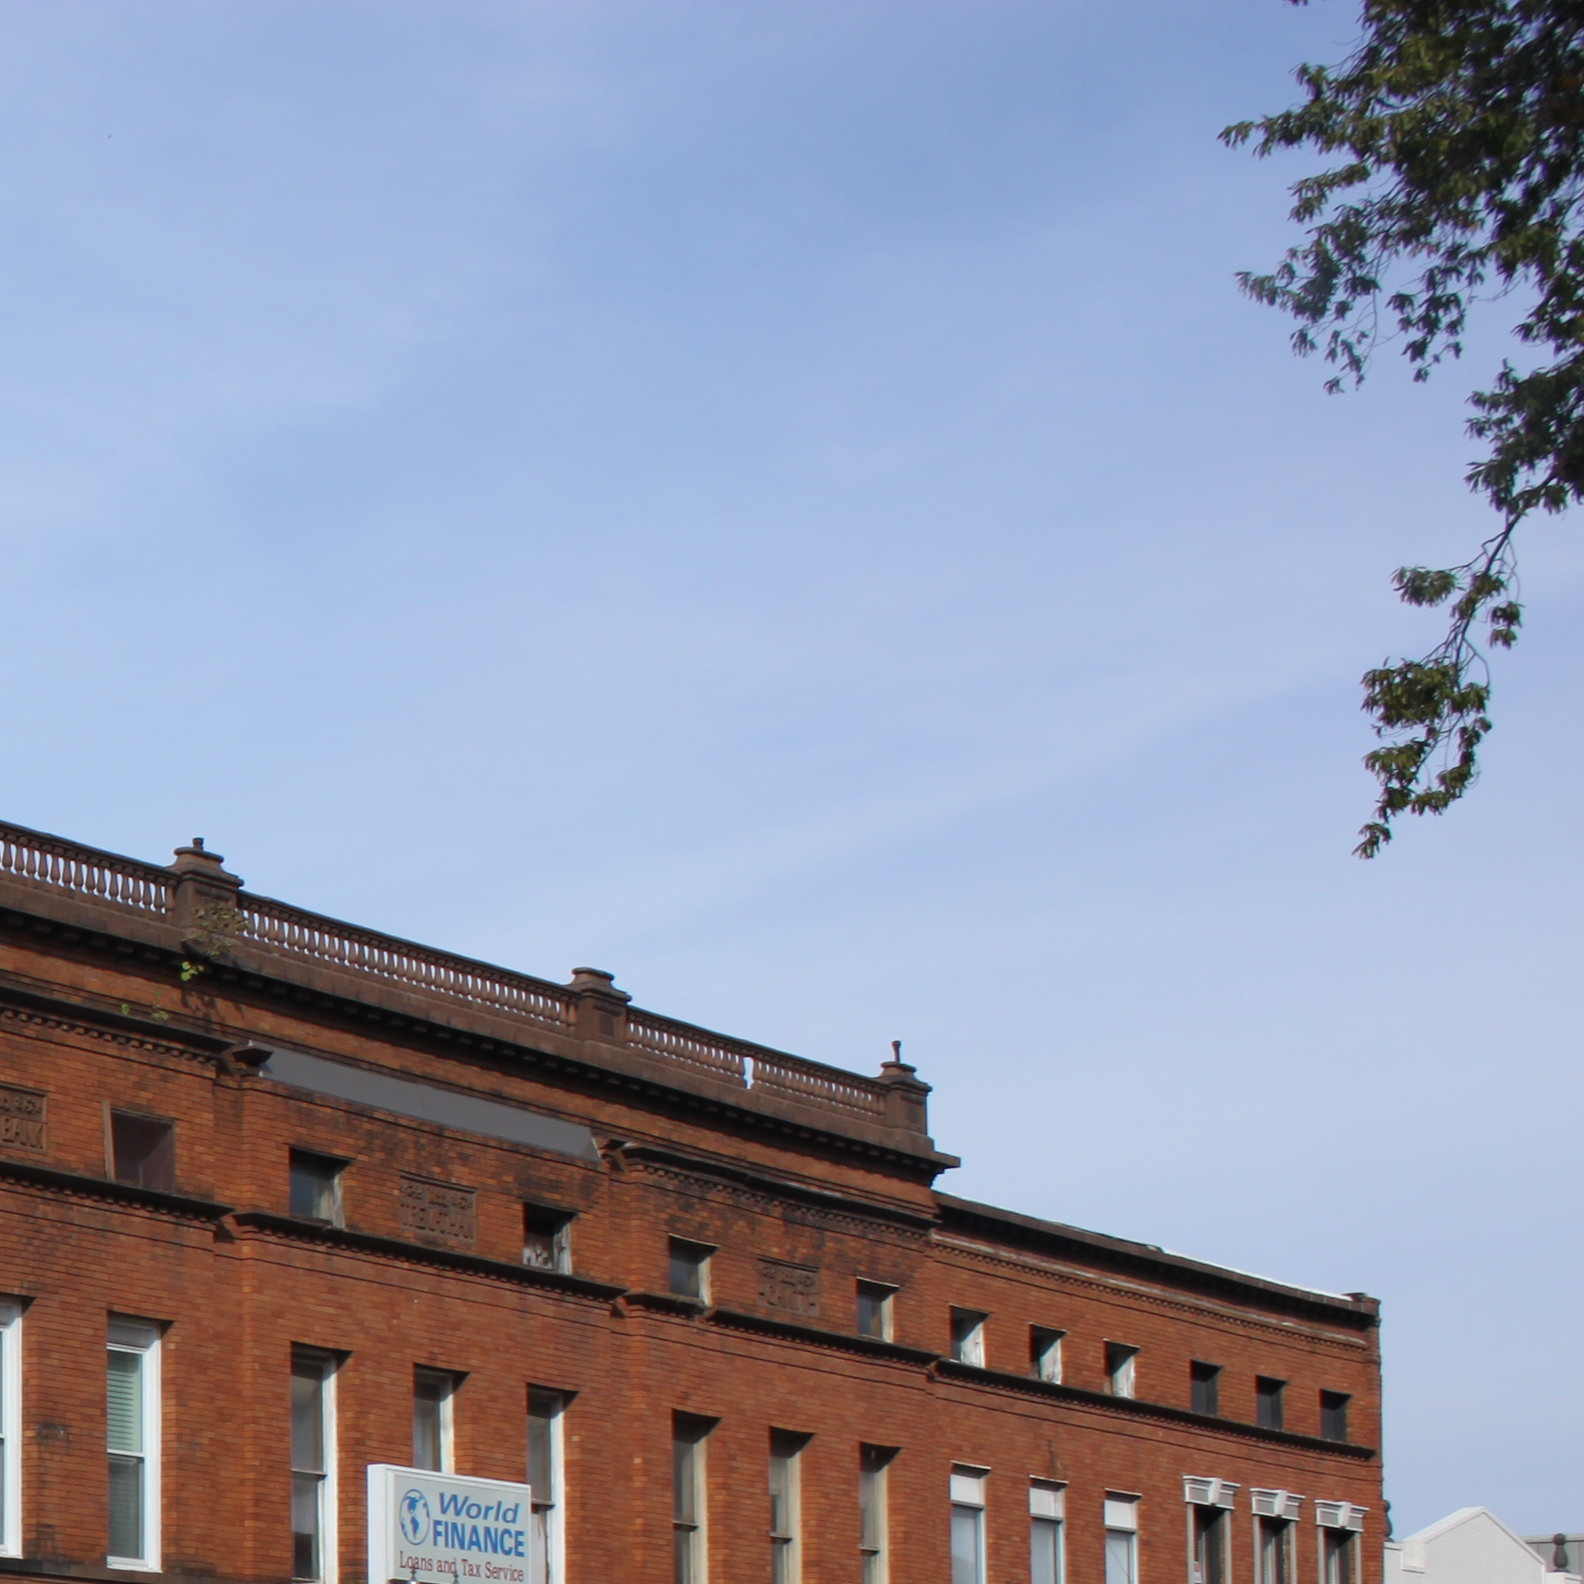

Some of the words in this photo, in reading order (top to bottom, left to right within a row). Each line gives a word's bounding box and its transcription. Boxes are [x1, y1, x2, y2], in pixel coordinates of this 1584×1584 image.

[438, 1491, 520, 1524] World
[432, 1519, 526, 1558] FINANCE
[399, 1550, 434, 1572] Loans
[436, 1557, 456, 1575] and
[461, 1558, 482, 1578] Tax
[484, 1561, 525, 1582] Service
